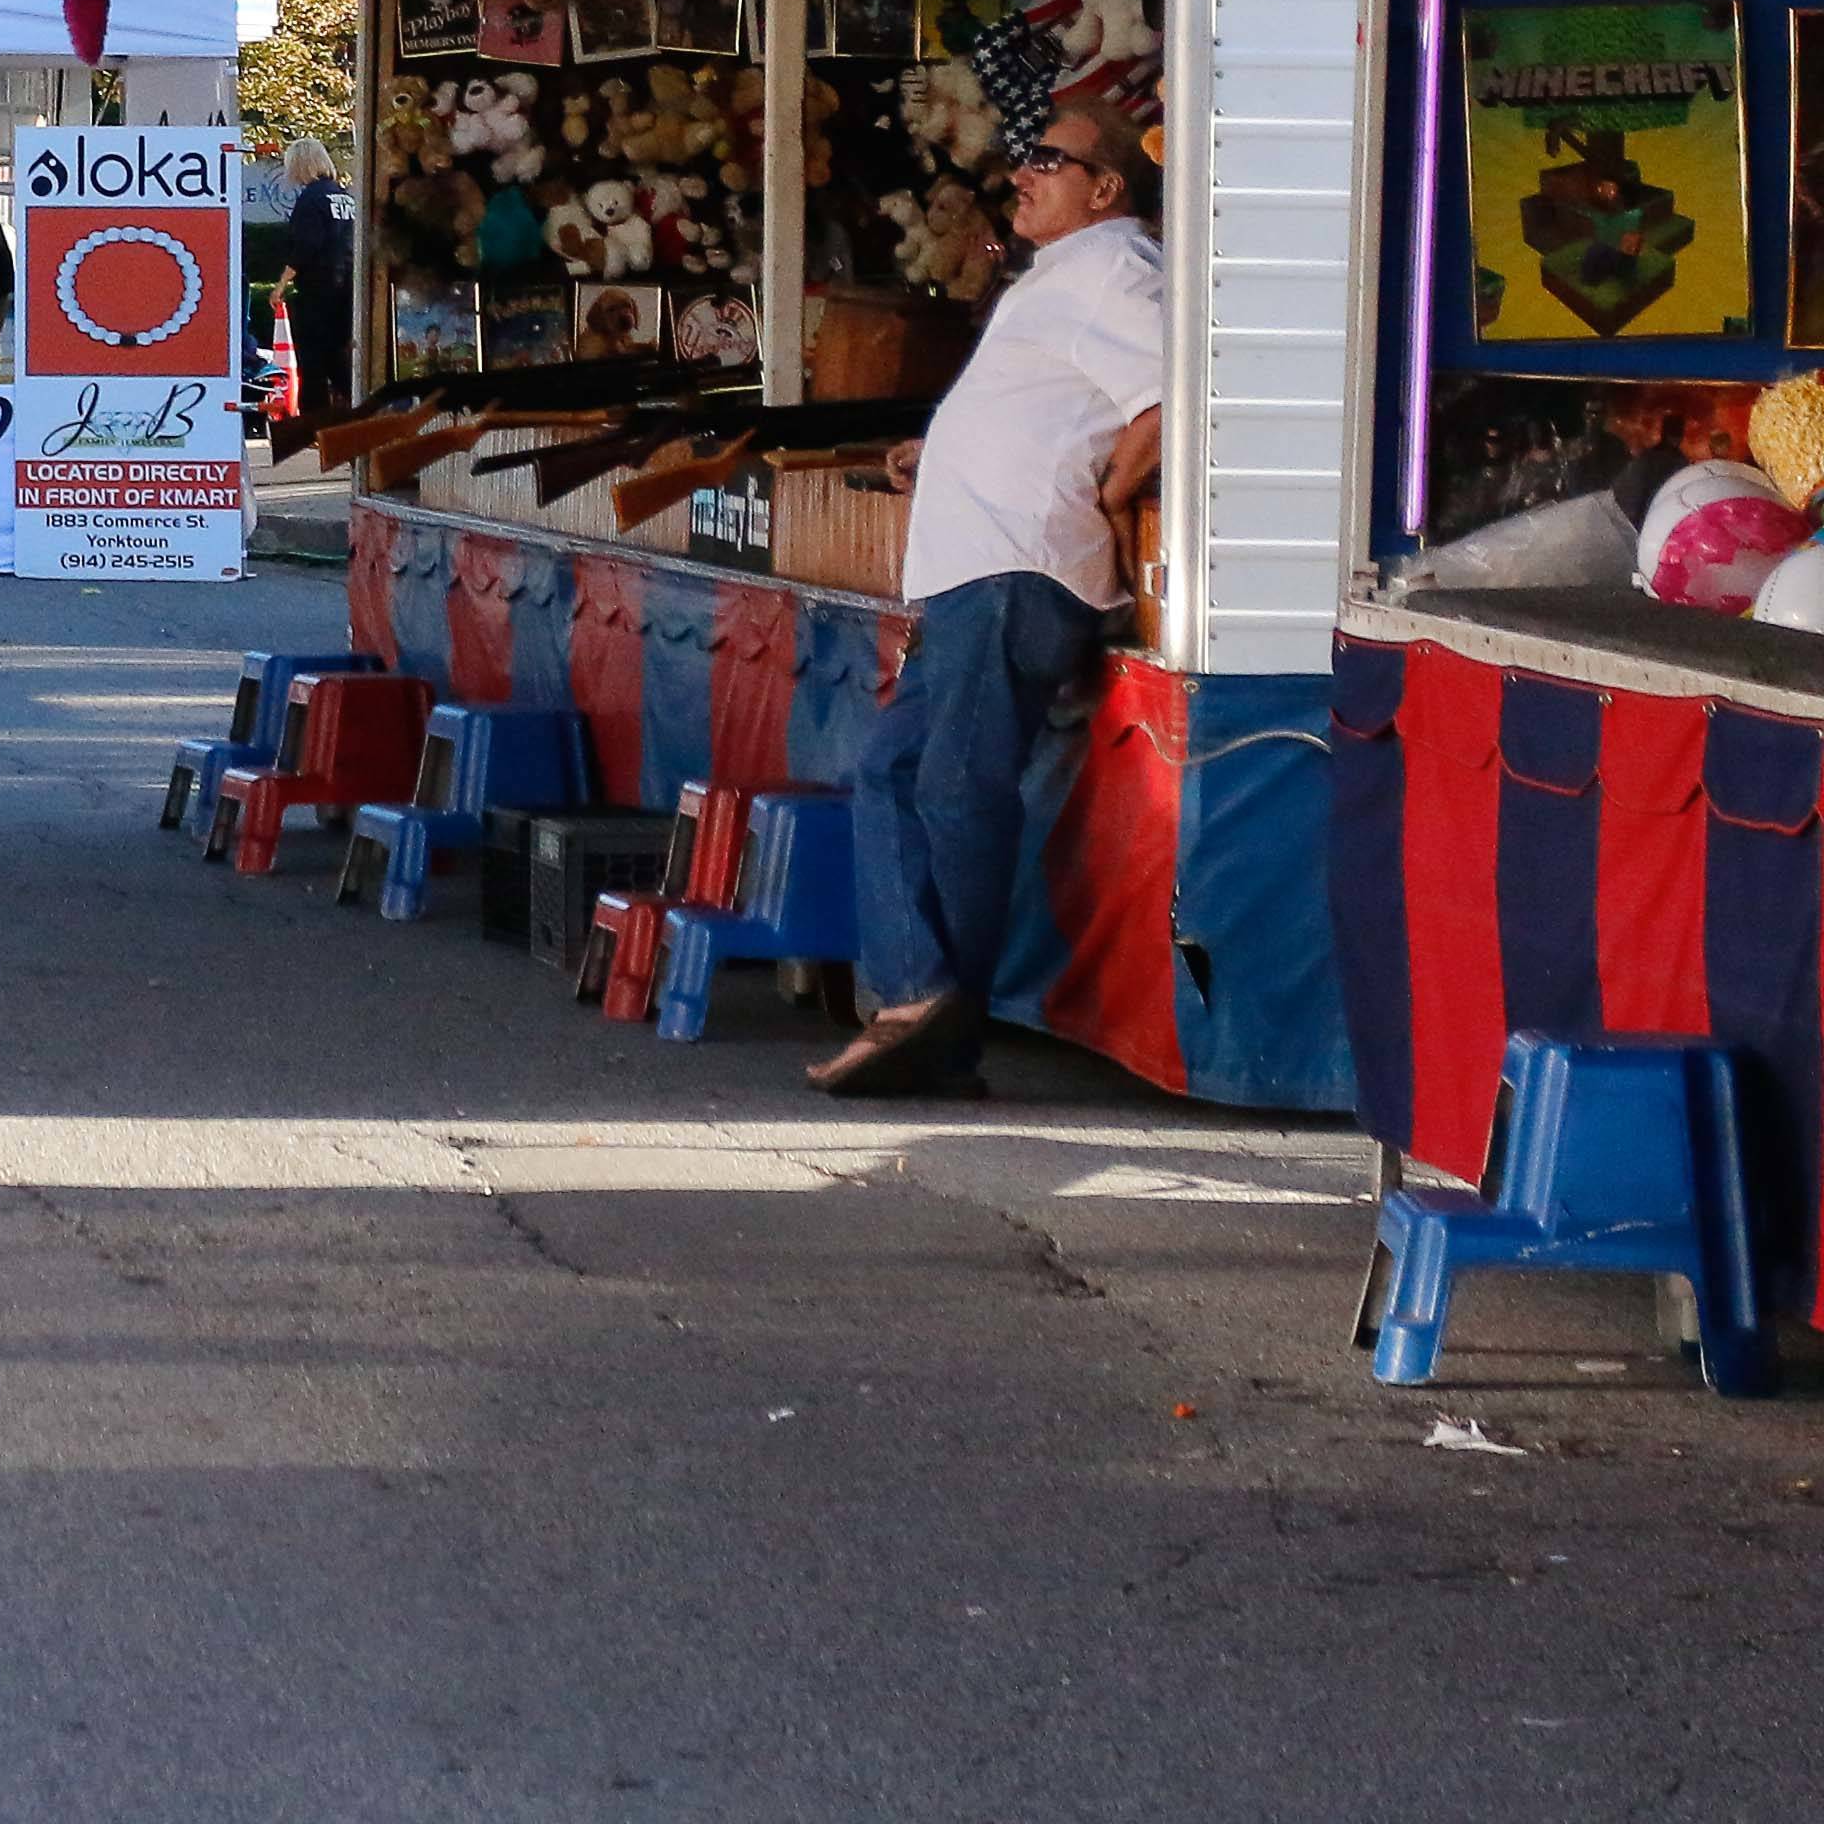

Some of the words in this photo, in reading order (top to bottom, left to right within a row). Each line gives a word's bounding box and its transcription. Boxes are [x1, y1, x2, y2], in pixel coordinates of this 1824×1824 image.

[1482, 62, 1738, 102] MINECRAFT
[42, 382, 99, 457] J
[146, 383, 207, 439] B
[26, 463, 123, 482] LOCATED
[129, 464, 229, 482] DIRECTLY
[18, 487, 40, 505] IN
[46, 488, 120, 506] FRONT
[125, 488, 155, 506] OF
[160, 488, 238, 506] KMART
[46, 513, 88, 527] 1883
[92, 514, 181, 528] Commerce
[186, 514, 209, 528] St.
[86, 534, 168, 548] Yorktown
[60, 553, 106, 569] (914)
[111, 554, 194, 569] 245-2515
